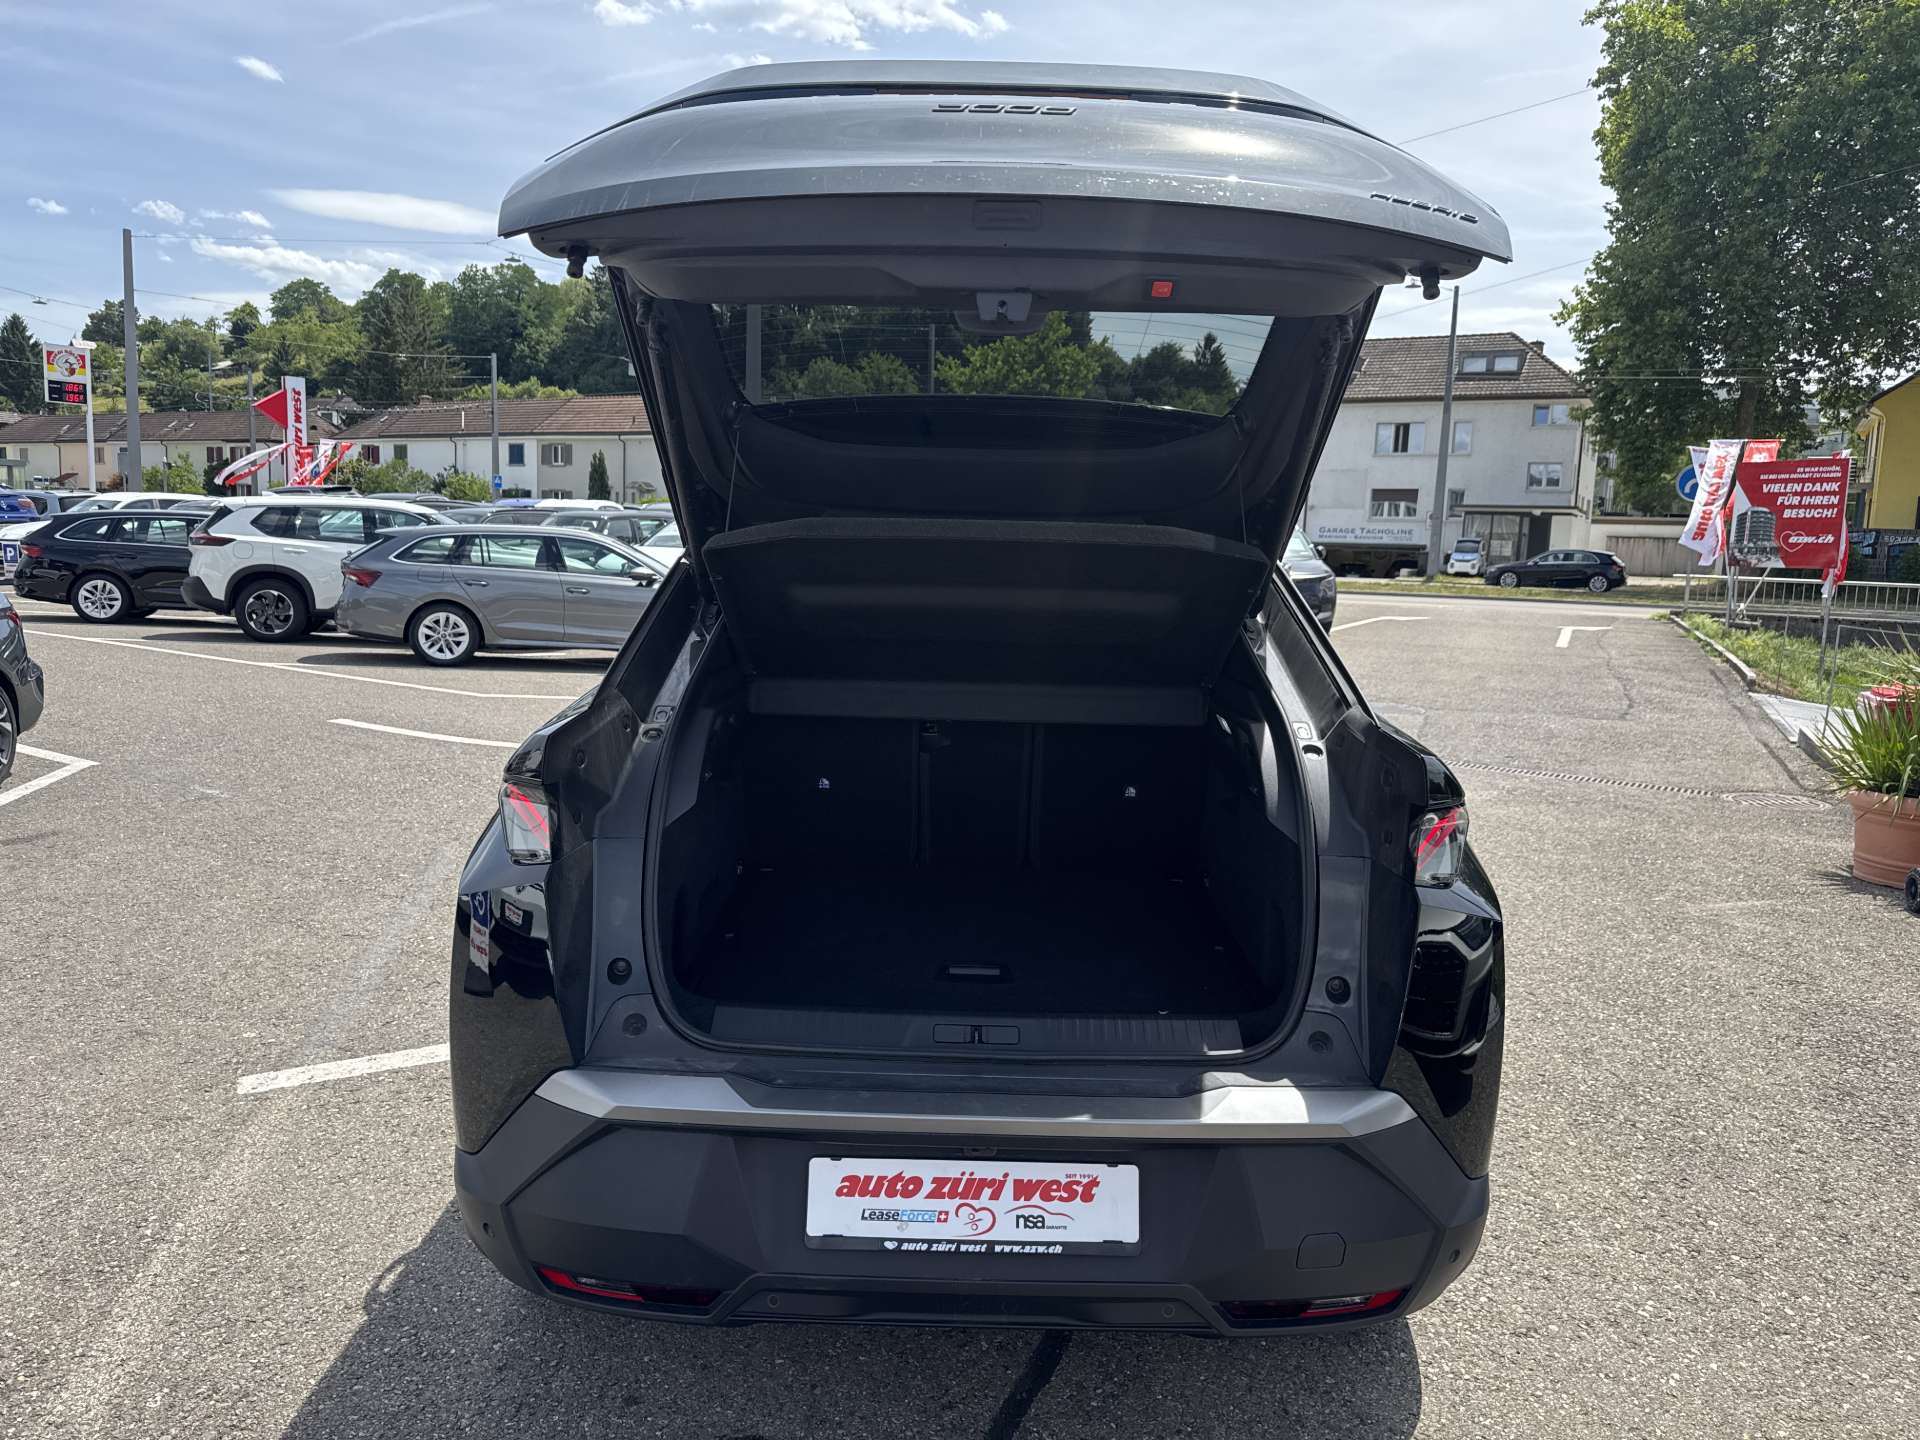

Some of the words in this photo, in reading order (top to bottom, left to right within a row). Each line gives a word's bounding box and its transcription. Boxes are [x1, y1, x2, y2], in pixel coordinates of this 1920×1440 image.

[292, 387, 302, 423] west
[1762, 483, 1802, 493] VIELEN
[1803, 482, 1841, 492] DANK
[1777, 493, 1801, 505] FÜR
[1801, 495, 1839, 505] IHREN
[1783, 508, 1837, 518] BESUCH!
[1318, 526, 1356, 534] GARAGE
[1360, 527, 1414, 536] TACHOLINE
[6, 546, 15, 560] P
[835, 1169, 924, 1199] auto
[924, 1170, 1009, 1200] züri
[1012, 1174, 1100, 1203] west
[861, 1208, 937, 1221] LeaseForce
[1016, 1214, 1046, 1229] nsa
[900, 1241, 928, 1251] auto
[930, 1241, 957, 1252] züri
[960, 1243, 988, 1252] west
[994, 1243, 1063, 1254] www.azw.ch
